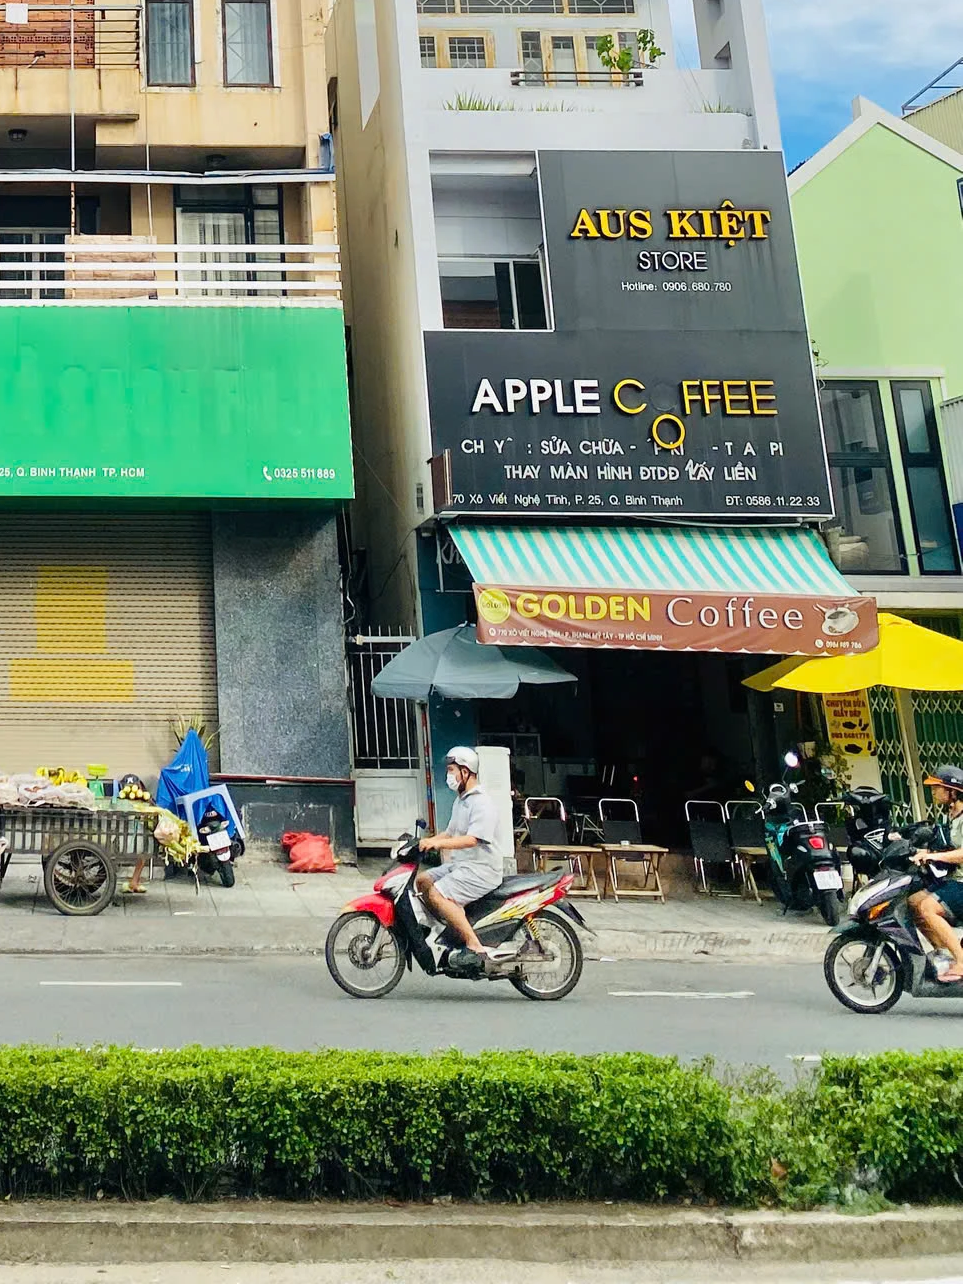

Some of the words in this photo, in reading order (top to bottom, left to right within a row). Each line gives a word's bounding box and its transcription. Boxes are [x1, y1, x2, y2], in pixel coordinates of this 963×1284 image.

[570, 208, 653, 239] AUS
[666, 199, 772, 247] KIỆT
[639, 251, 708, 271] STORE
[621, 281, 658, 292] Hotline:
[471, 378, 601, 414] APPLE
[540, 435, 572, 455] SỬA
[579, 437, 625, 455] CHỮA
[101, 467, 118, 478] TP.
[120, 467, 146, 478] HCM
[274, 468, 298, 479] 0325
[300, 468, 316, 479] 511
[317, 468, 336, 480] 889
[503, 465, 541, 479] THAY
[550, 462, 589, 480] MÀN
[597, 462, 633, 480] HÌNH
[723, 460, 757, 481] LIỀN
[452, 494, 465, 504] 70
[469, 494, 484, 505] Xô
[514, 494, 540, 508] Nghệ
[575, 494, 585, 505] P.
[588, 494, 604, 507] 25,
[609, 494, 621, 506] Q.
[650, 495, 683, 509] Thạnh
[725, 495, 743, 506] ĐT:
[515, 591, 651, 622] GOLDEN
[666, 596, 804, 630] Coffee
